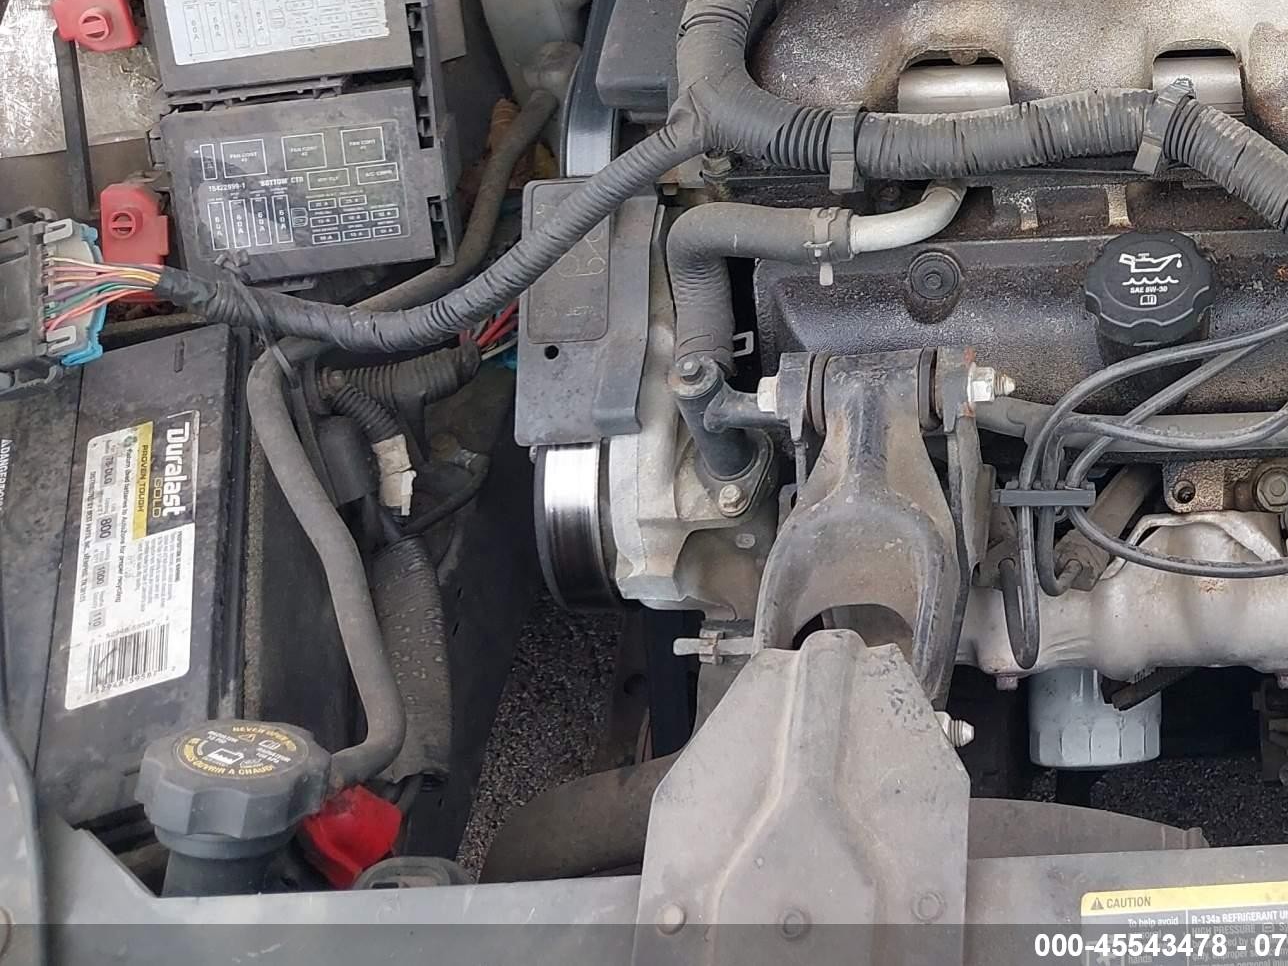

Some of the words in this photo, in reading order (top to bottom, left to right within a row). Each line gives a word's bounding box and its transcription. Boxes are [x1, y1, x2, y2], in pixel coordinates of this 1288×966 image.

[1130, 286, 1144, 294] SAE
[140, 444, 149, 480] PROVEN
[162, 422, 190, 516] Duralast
[137, 483, 146, 512] TOUGH
[152, 477, 163, 517] GOLD
[100, 518, 112, 538] 800
[119, 516, 127, 544] AutoZone
[96, 566, 106, 584] 1000
[114, 576, 124, 602] recycling
[92, 612, 102, 626] 110
[238, 765, 274, 775] CHAUD
[1106, 897, 1151, 908] CAUTION
[1128, 919, 1136, 928] To
[1138, 917, 1154, 928] help
[1158, 917, 1179, 926] avoid
[1192, 914, 1220, 924] R-134a
[1222, 911, 1278, 923] REFRIGERANT
[1213, 924, 1256, 934] PRESSURE
